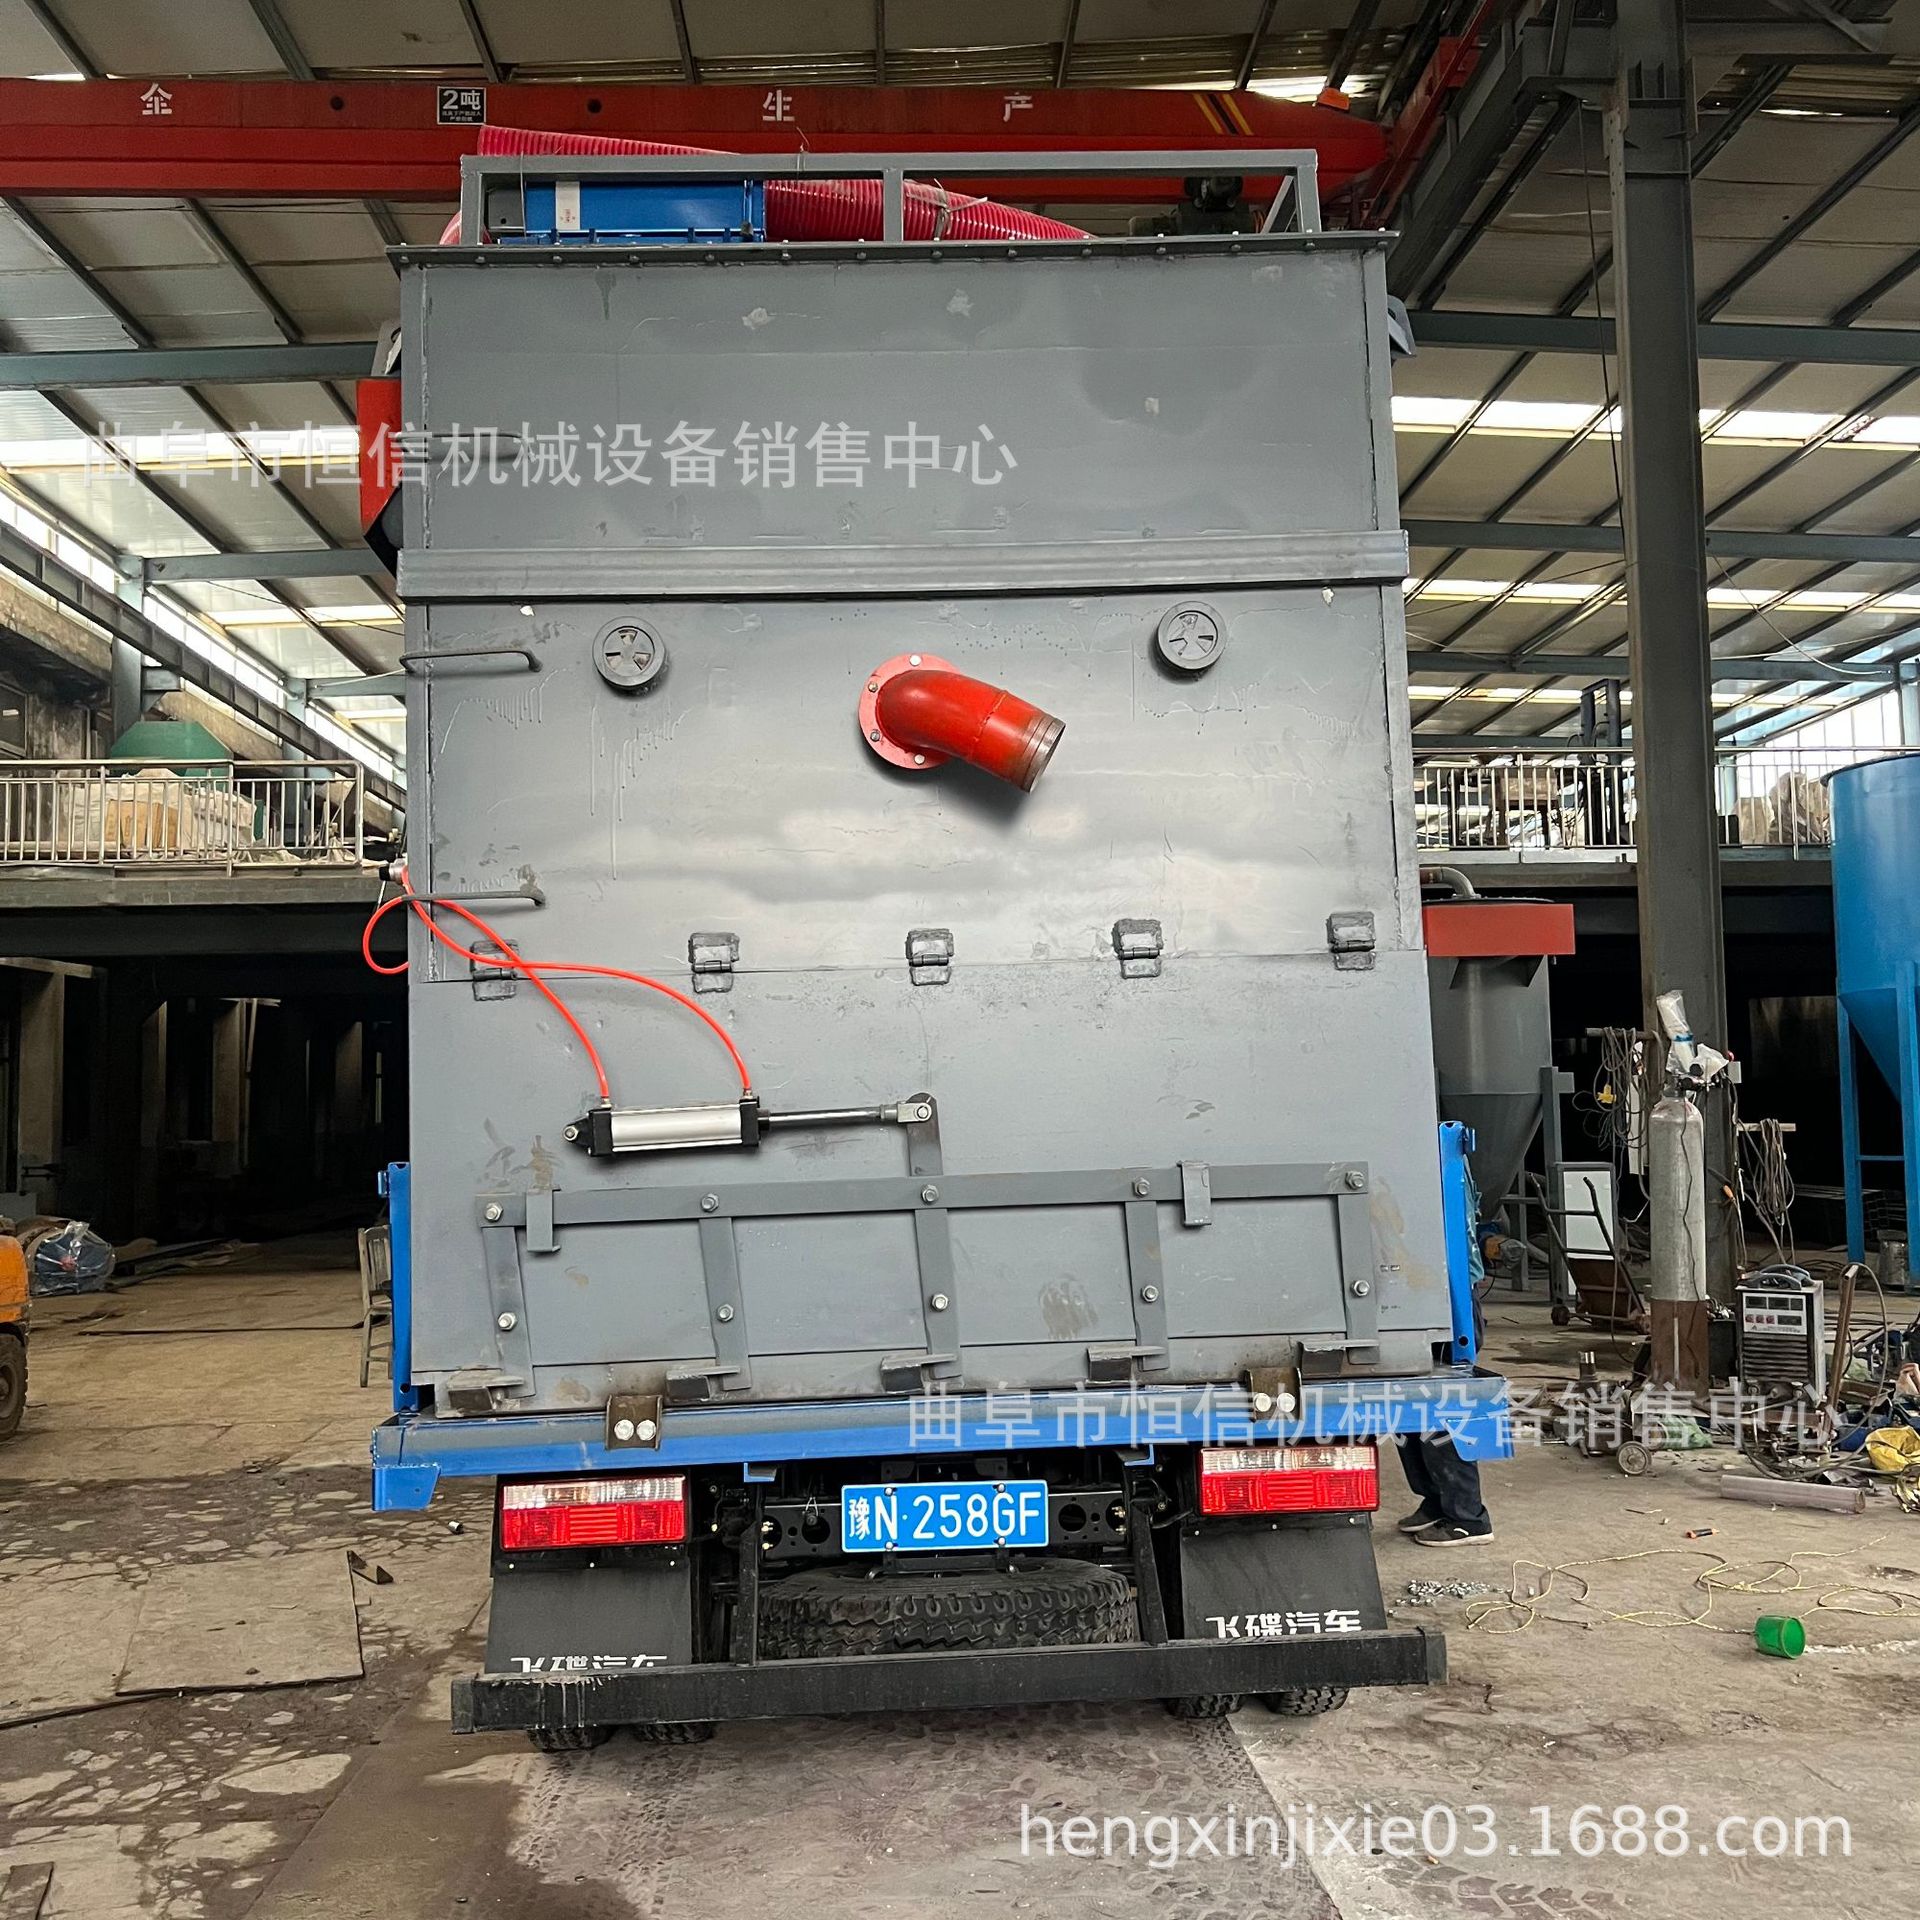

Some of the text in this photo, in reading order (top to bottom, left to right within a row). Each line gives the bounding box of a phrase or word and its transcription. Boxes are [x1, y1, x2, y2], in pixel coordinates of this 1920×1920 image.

[442, 89, 482, 110] 2吨
[762, 89, 795, 121] 生
[1003, 92, 1034, 122] 产
[1205, 1609, 1362, 1639] 飞碟汽车
